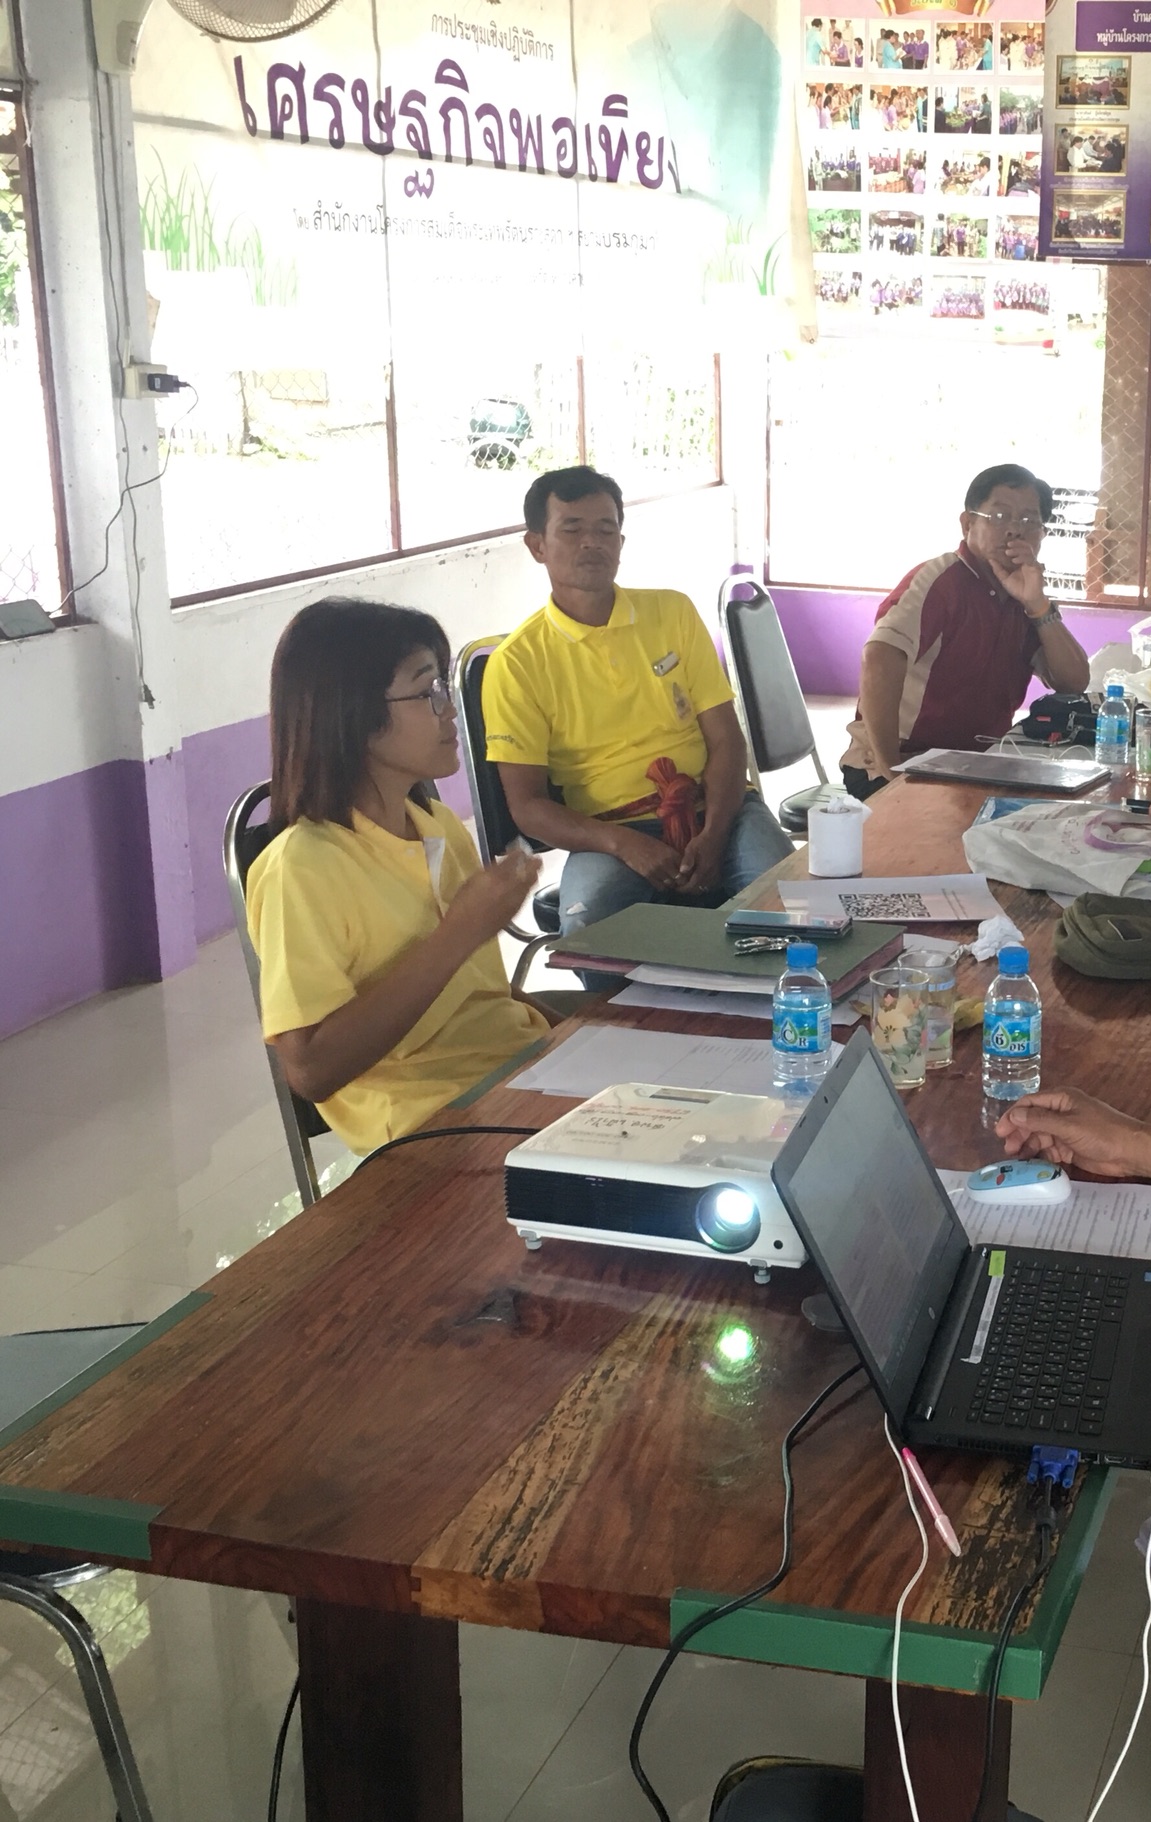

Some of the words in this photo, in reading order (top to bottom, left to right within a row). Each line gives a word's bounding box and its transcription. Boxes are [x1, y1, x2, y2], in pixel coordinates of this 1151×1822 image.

[431, 13, 553, 62] การประชุมเชิงปฏิบัติการ
